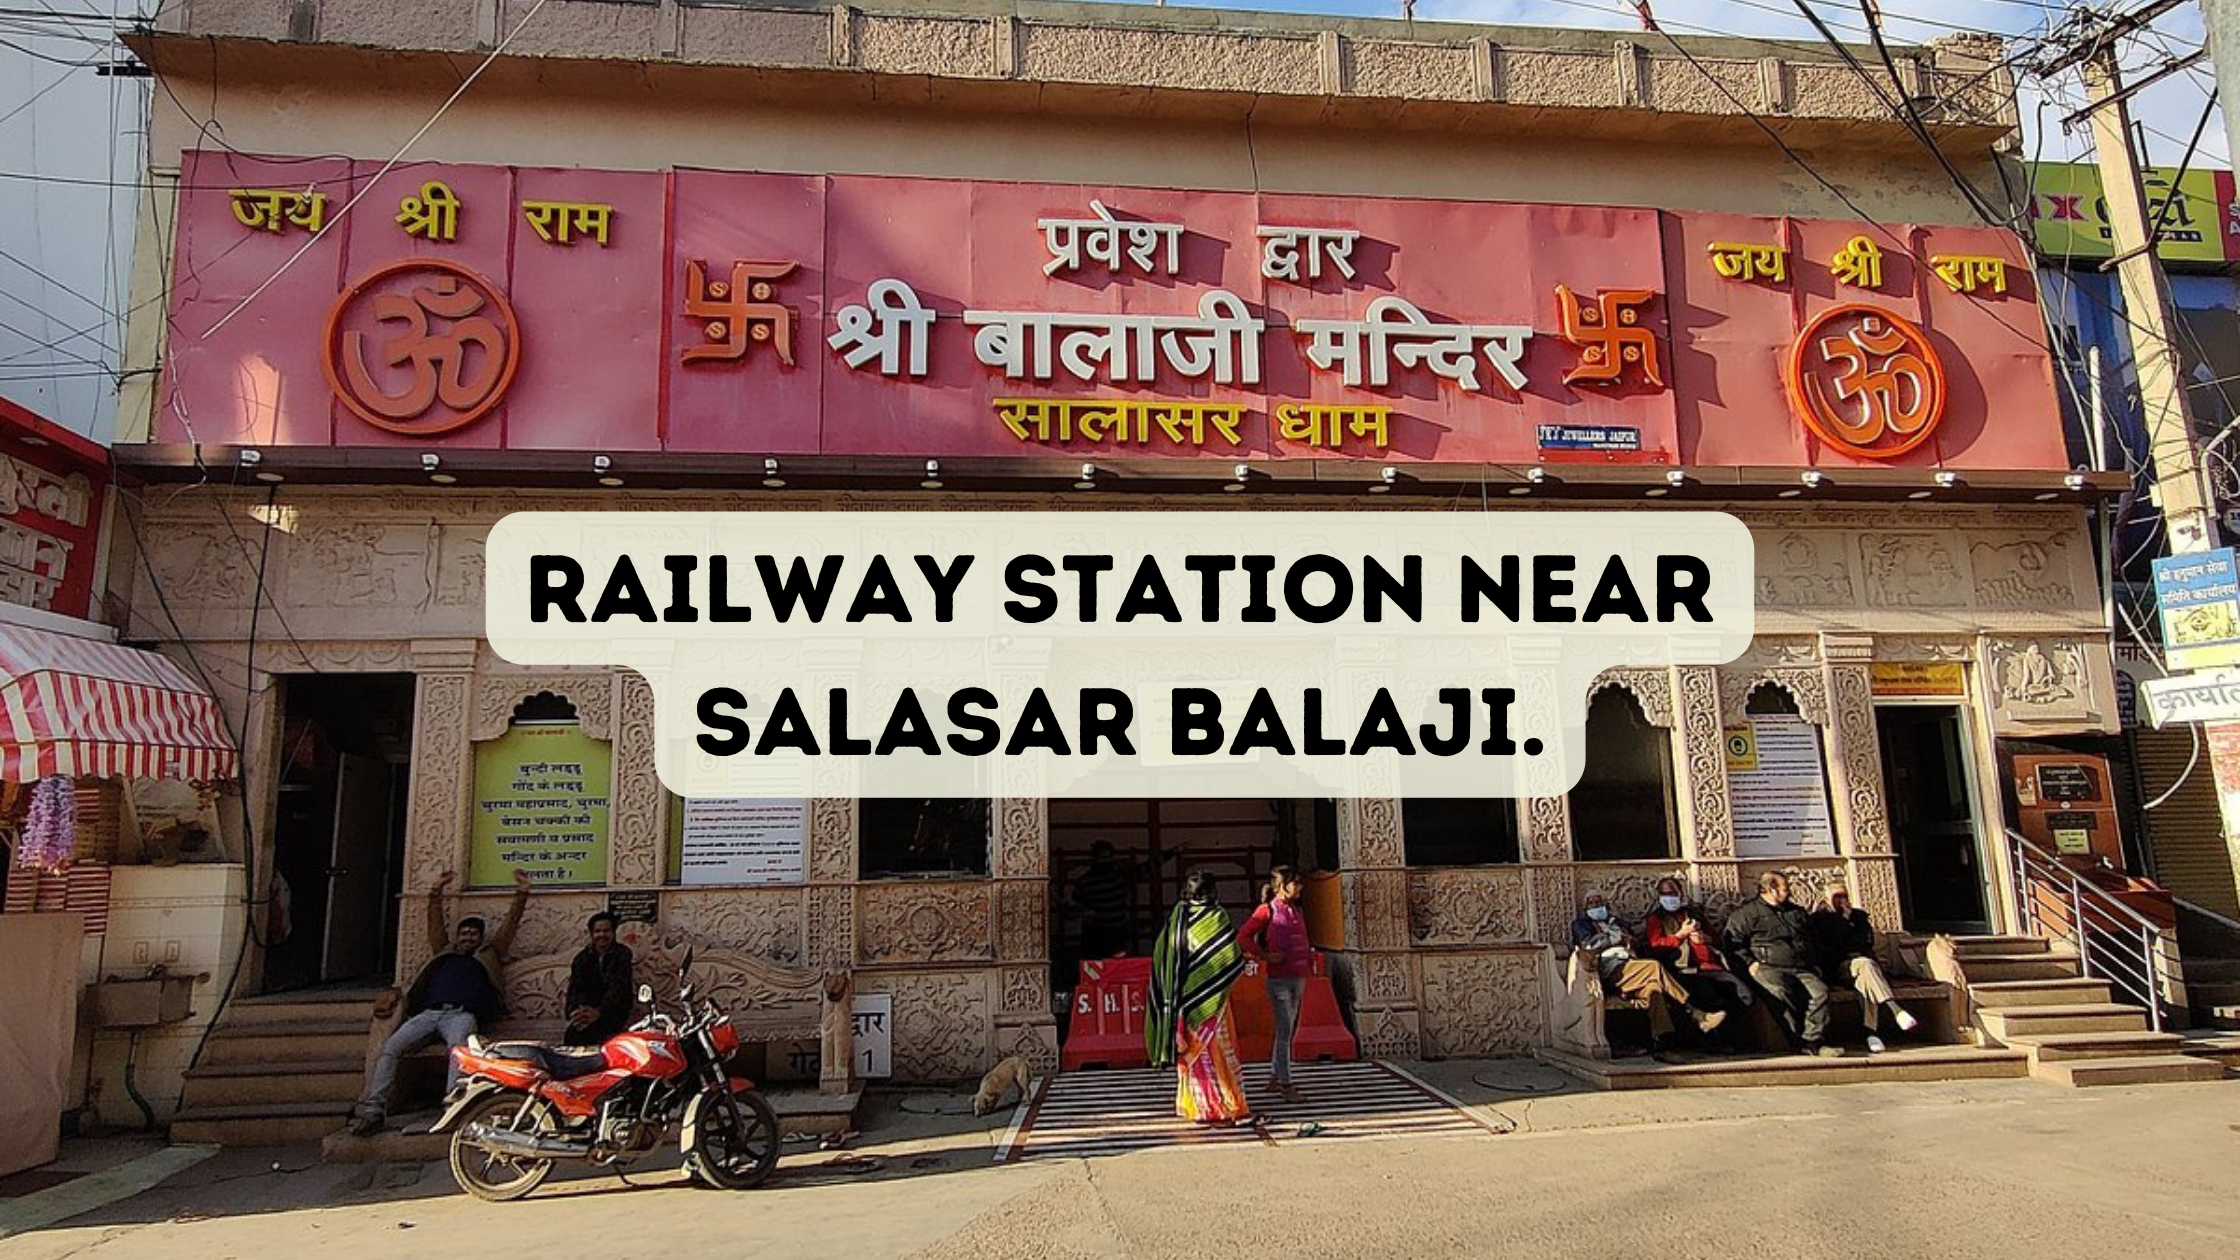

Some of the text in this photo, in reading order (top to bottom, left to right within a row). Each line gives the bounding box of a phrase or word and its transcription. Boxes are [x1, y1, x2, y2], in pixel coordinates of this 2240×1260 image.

[228, 181, 613, 245] जय श्री राम
[1037, 199, 1360, 280] प्रवेश द्वार
[1708, 236, 2007, 292] जय श्री राम
[827, 278, 1533, 391] श्री बालाजी मन्दिर
[993, 398, 1393, 447] सालासर धाम
